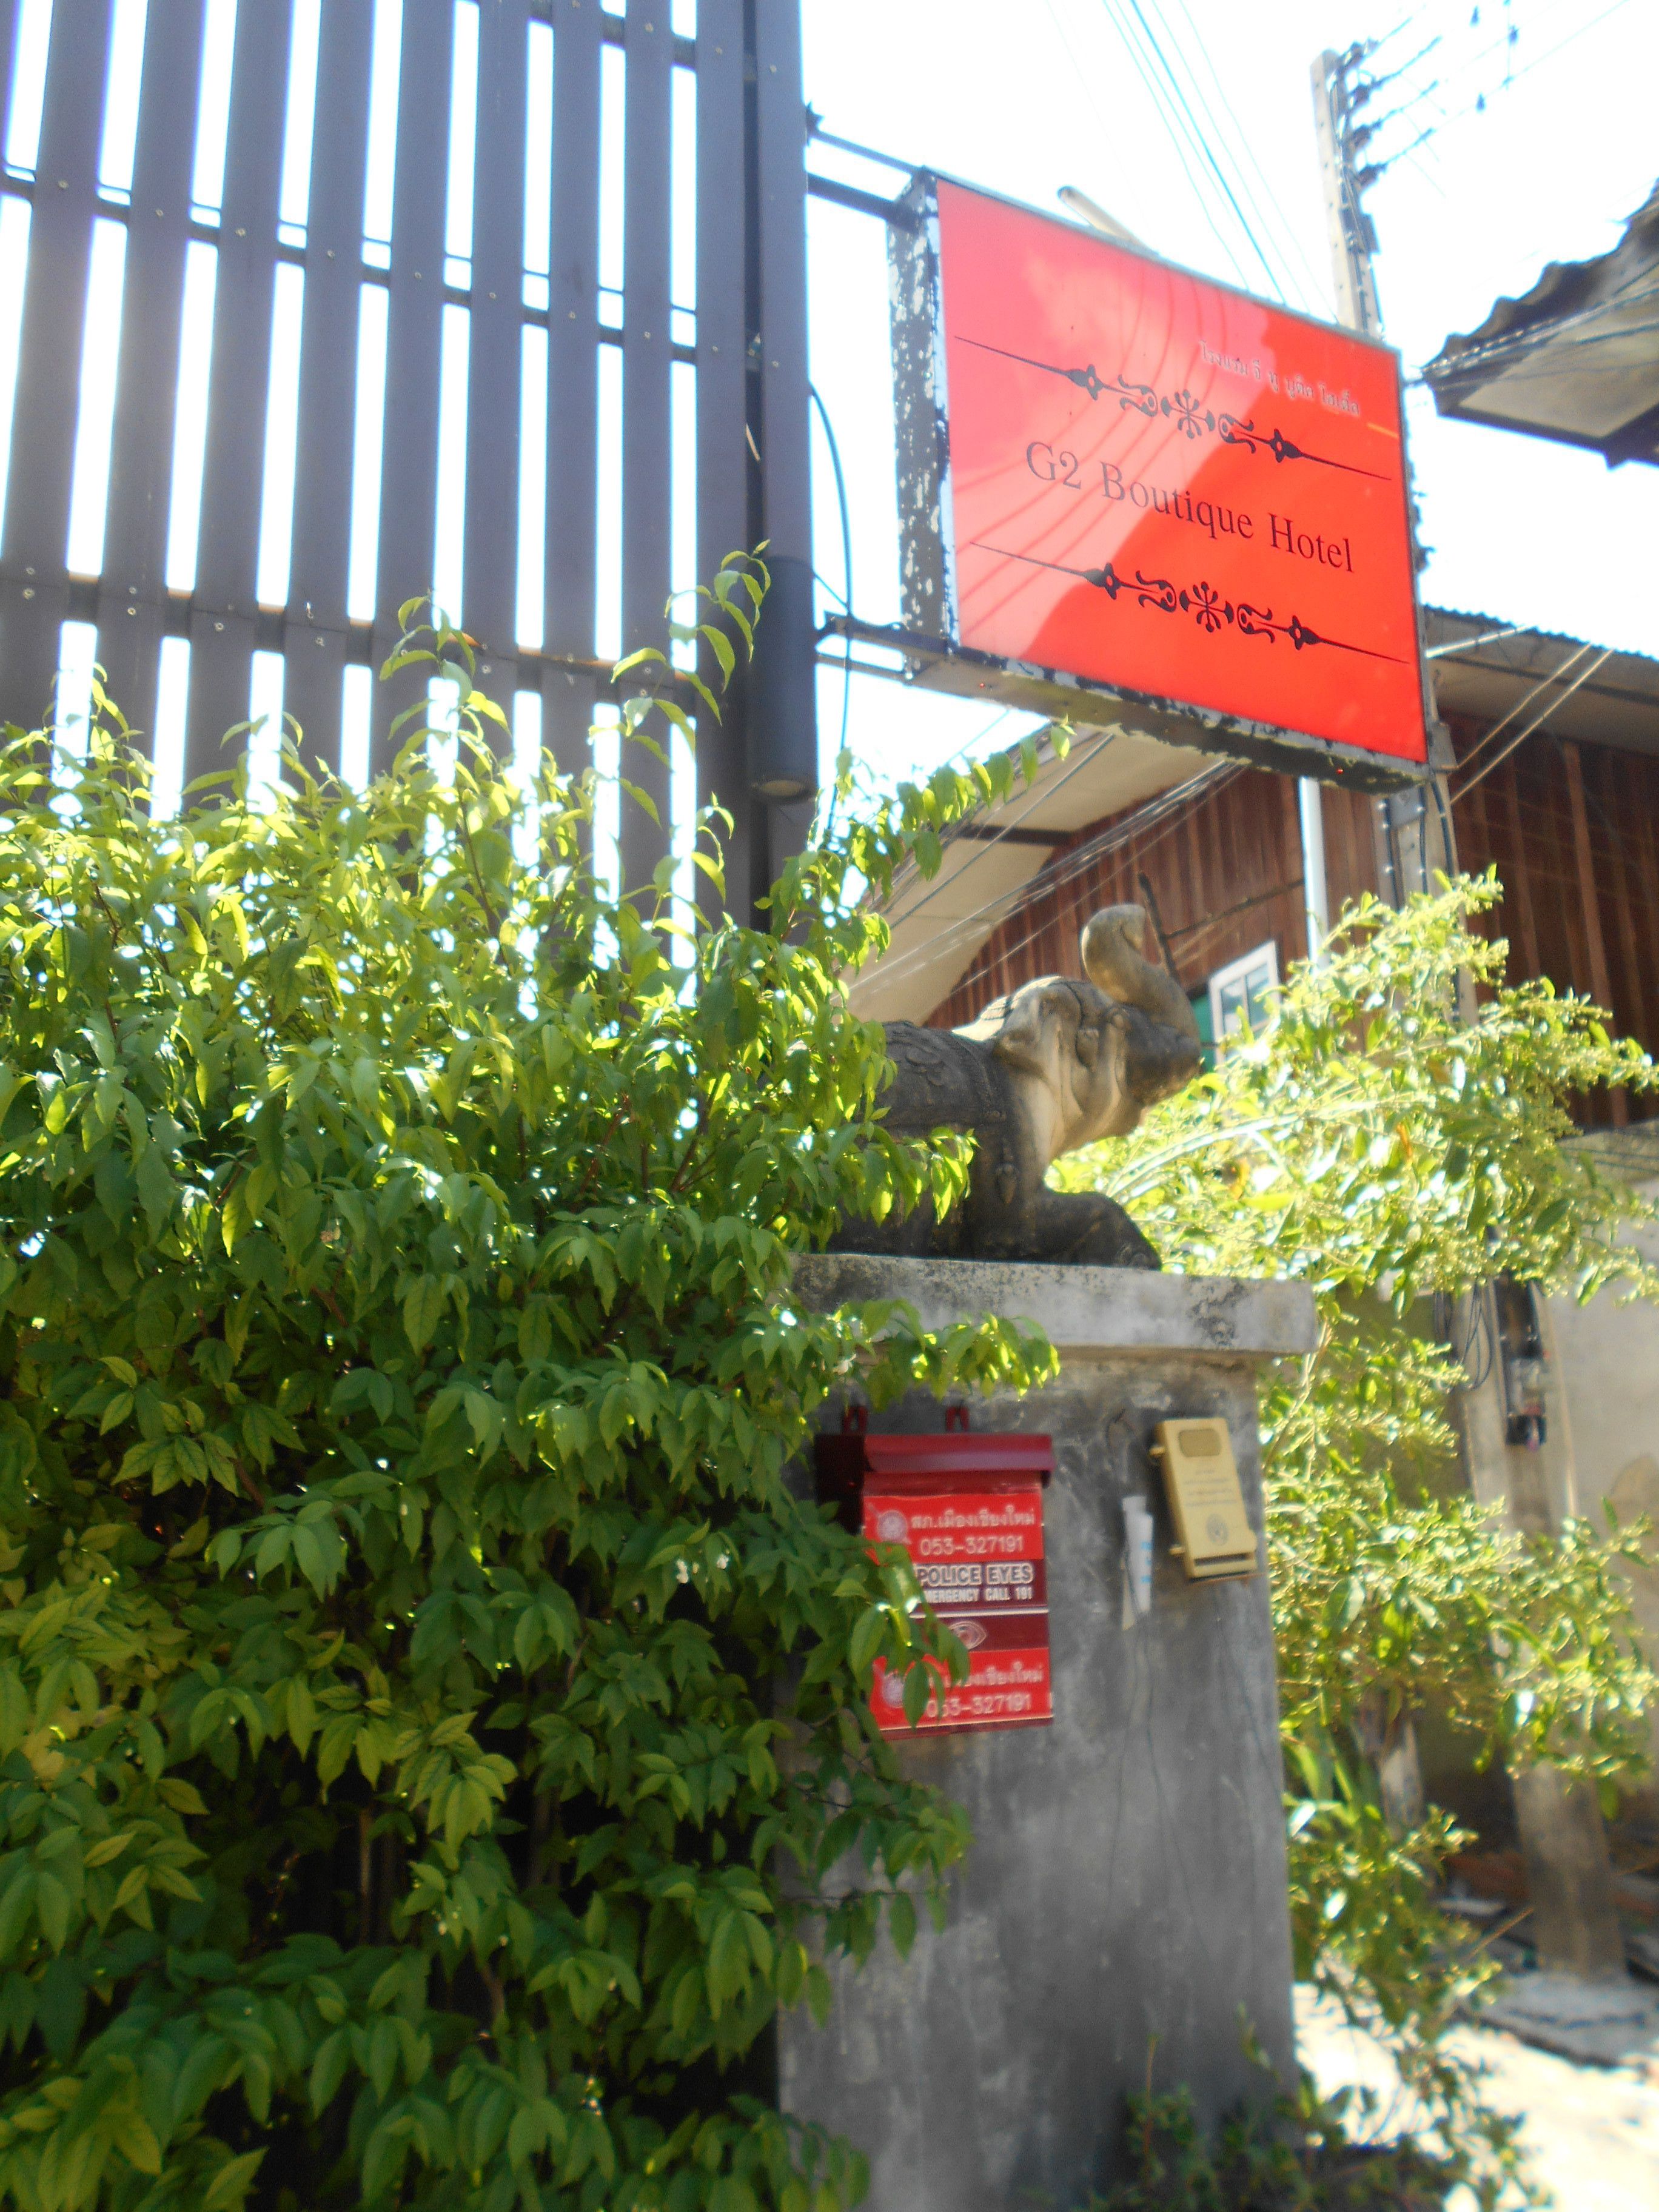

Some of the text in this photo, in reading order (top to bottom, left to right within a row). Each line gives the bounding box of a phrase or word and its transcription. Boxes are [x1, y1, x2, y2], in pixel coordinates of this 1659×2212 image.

[1025, 441, 1355, 572] G2 Boutique Hotel
[920, 1535, 1024, 1556] 053-327191
[914, 1563, 1034, 1586] POLICE EYES
[923, 1587, 1033, 1603] MERGENCY CALL 191
